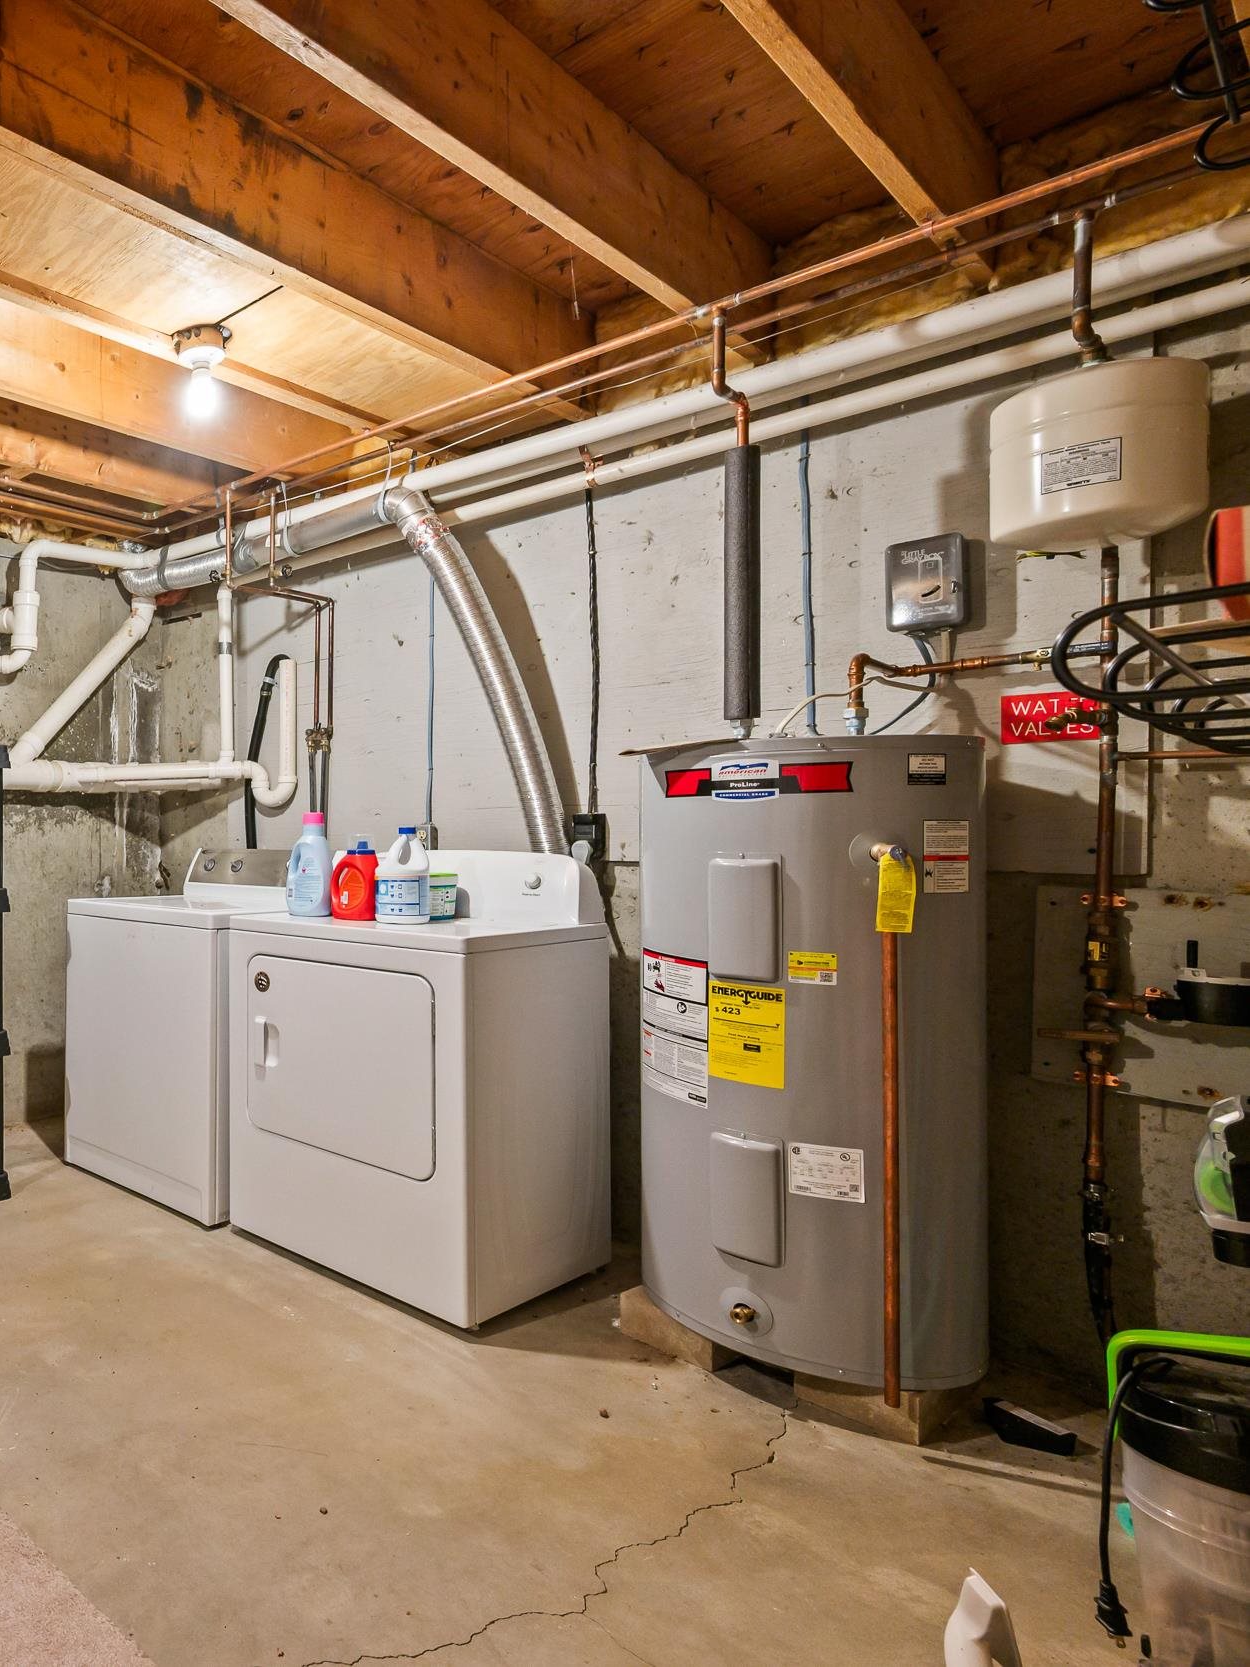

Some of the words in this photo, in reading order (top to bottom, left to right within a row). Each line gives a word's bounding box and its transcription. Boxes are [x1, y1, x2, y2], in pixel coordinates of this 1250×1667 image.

[1011, 697, 1094, 716] WAT
[1011, 721, 1094, 736] VALES
[712, 986, 783, 1002] ENERGYGUIDE
[721, 1006, 741, 1015] 423
